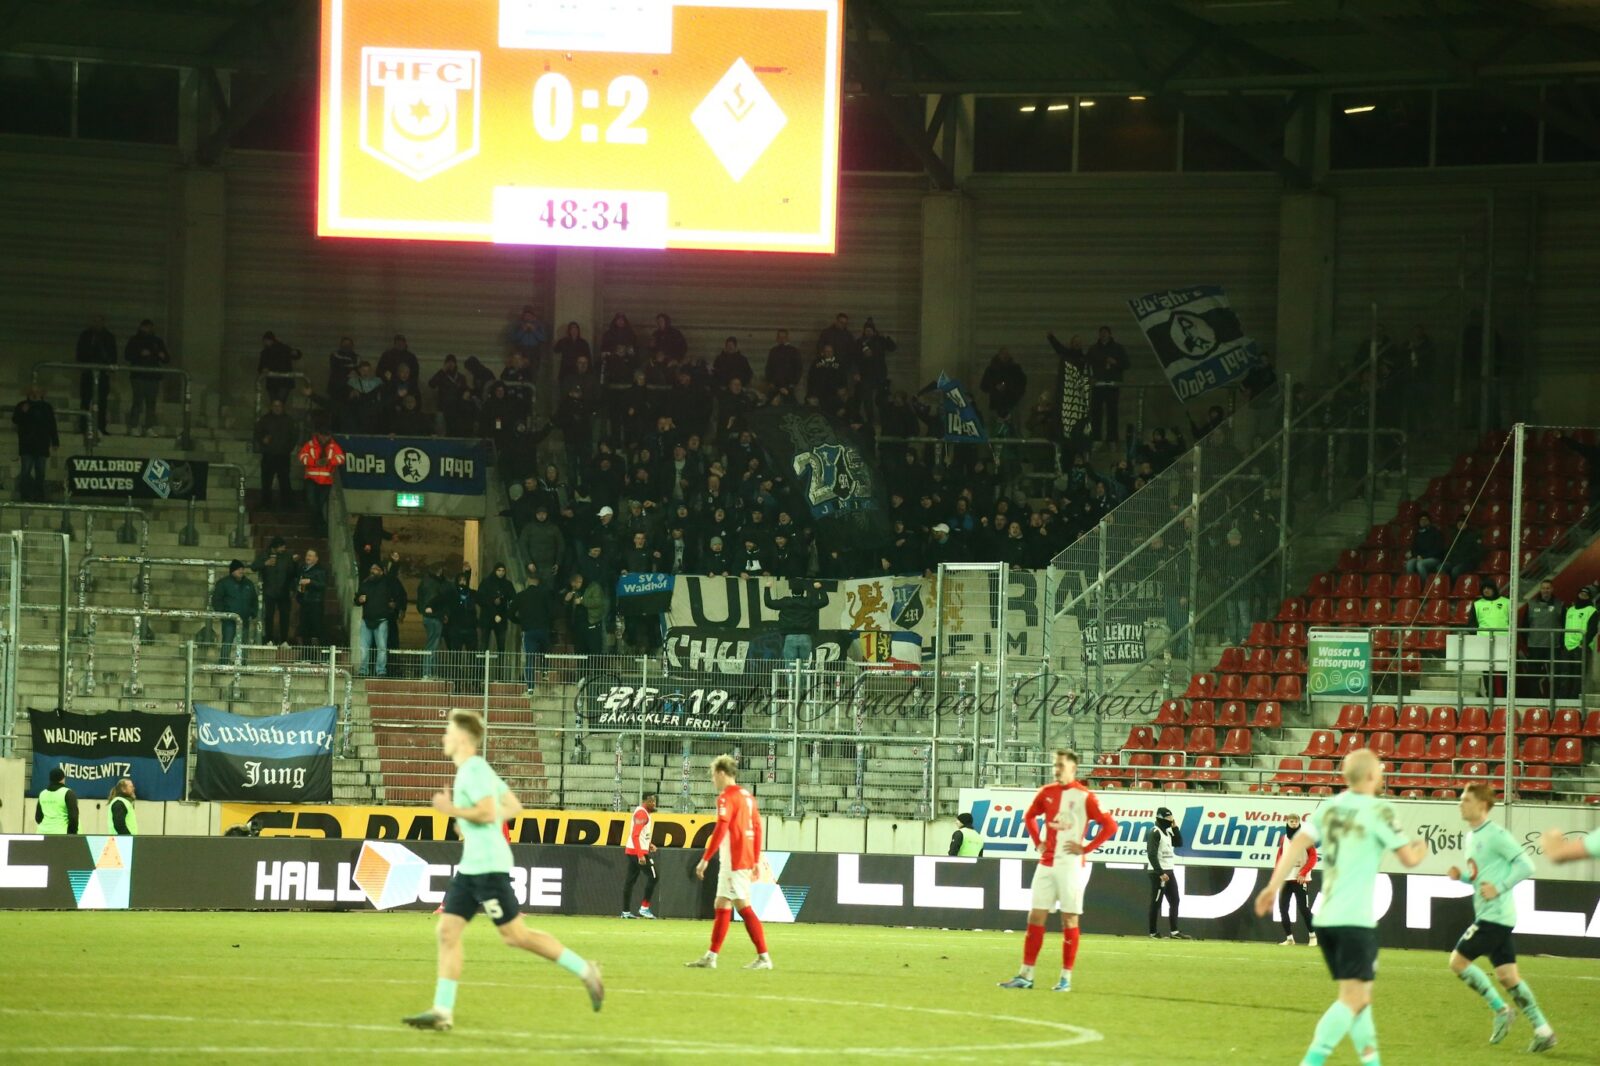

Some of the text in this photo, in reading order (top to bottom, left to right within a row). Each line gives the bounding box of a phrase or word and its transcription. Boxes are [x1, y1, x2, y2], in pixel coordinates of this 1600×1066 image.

[378, 61, 463, 83] HFC
[532, 71, 650, 144] 0:2
[539, 199, 630, 231] 48:34
[73, 459, 143, 473] WALDHOF
[439, 457, 474, 479] 1999
[73, 477, 134, 490] WOLVES
[623, 579, 669, 594] Waldhof
[639, 574, 654, 584] SV
[1318, 646, 1361, 657] Wasser &
[1312, 658, 1367, 670] Entsorgung
[199, 723, 333, 751] Cuxhavener
[59, 761, 131, 781] MEUSELWITZ
[242, 761, 307, 789] Jung
